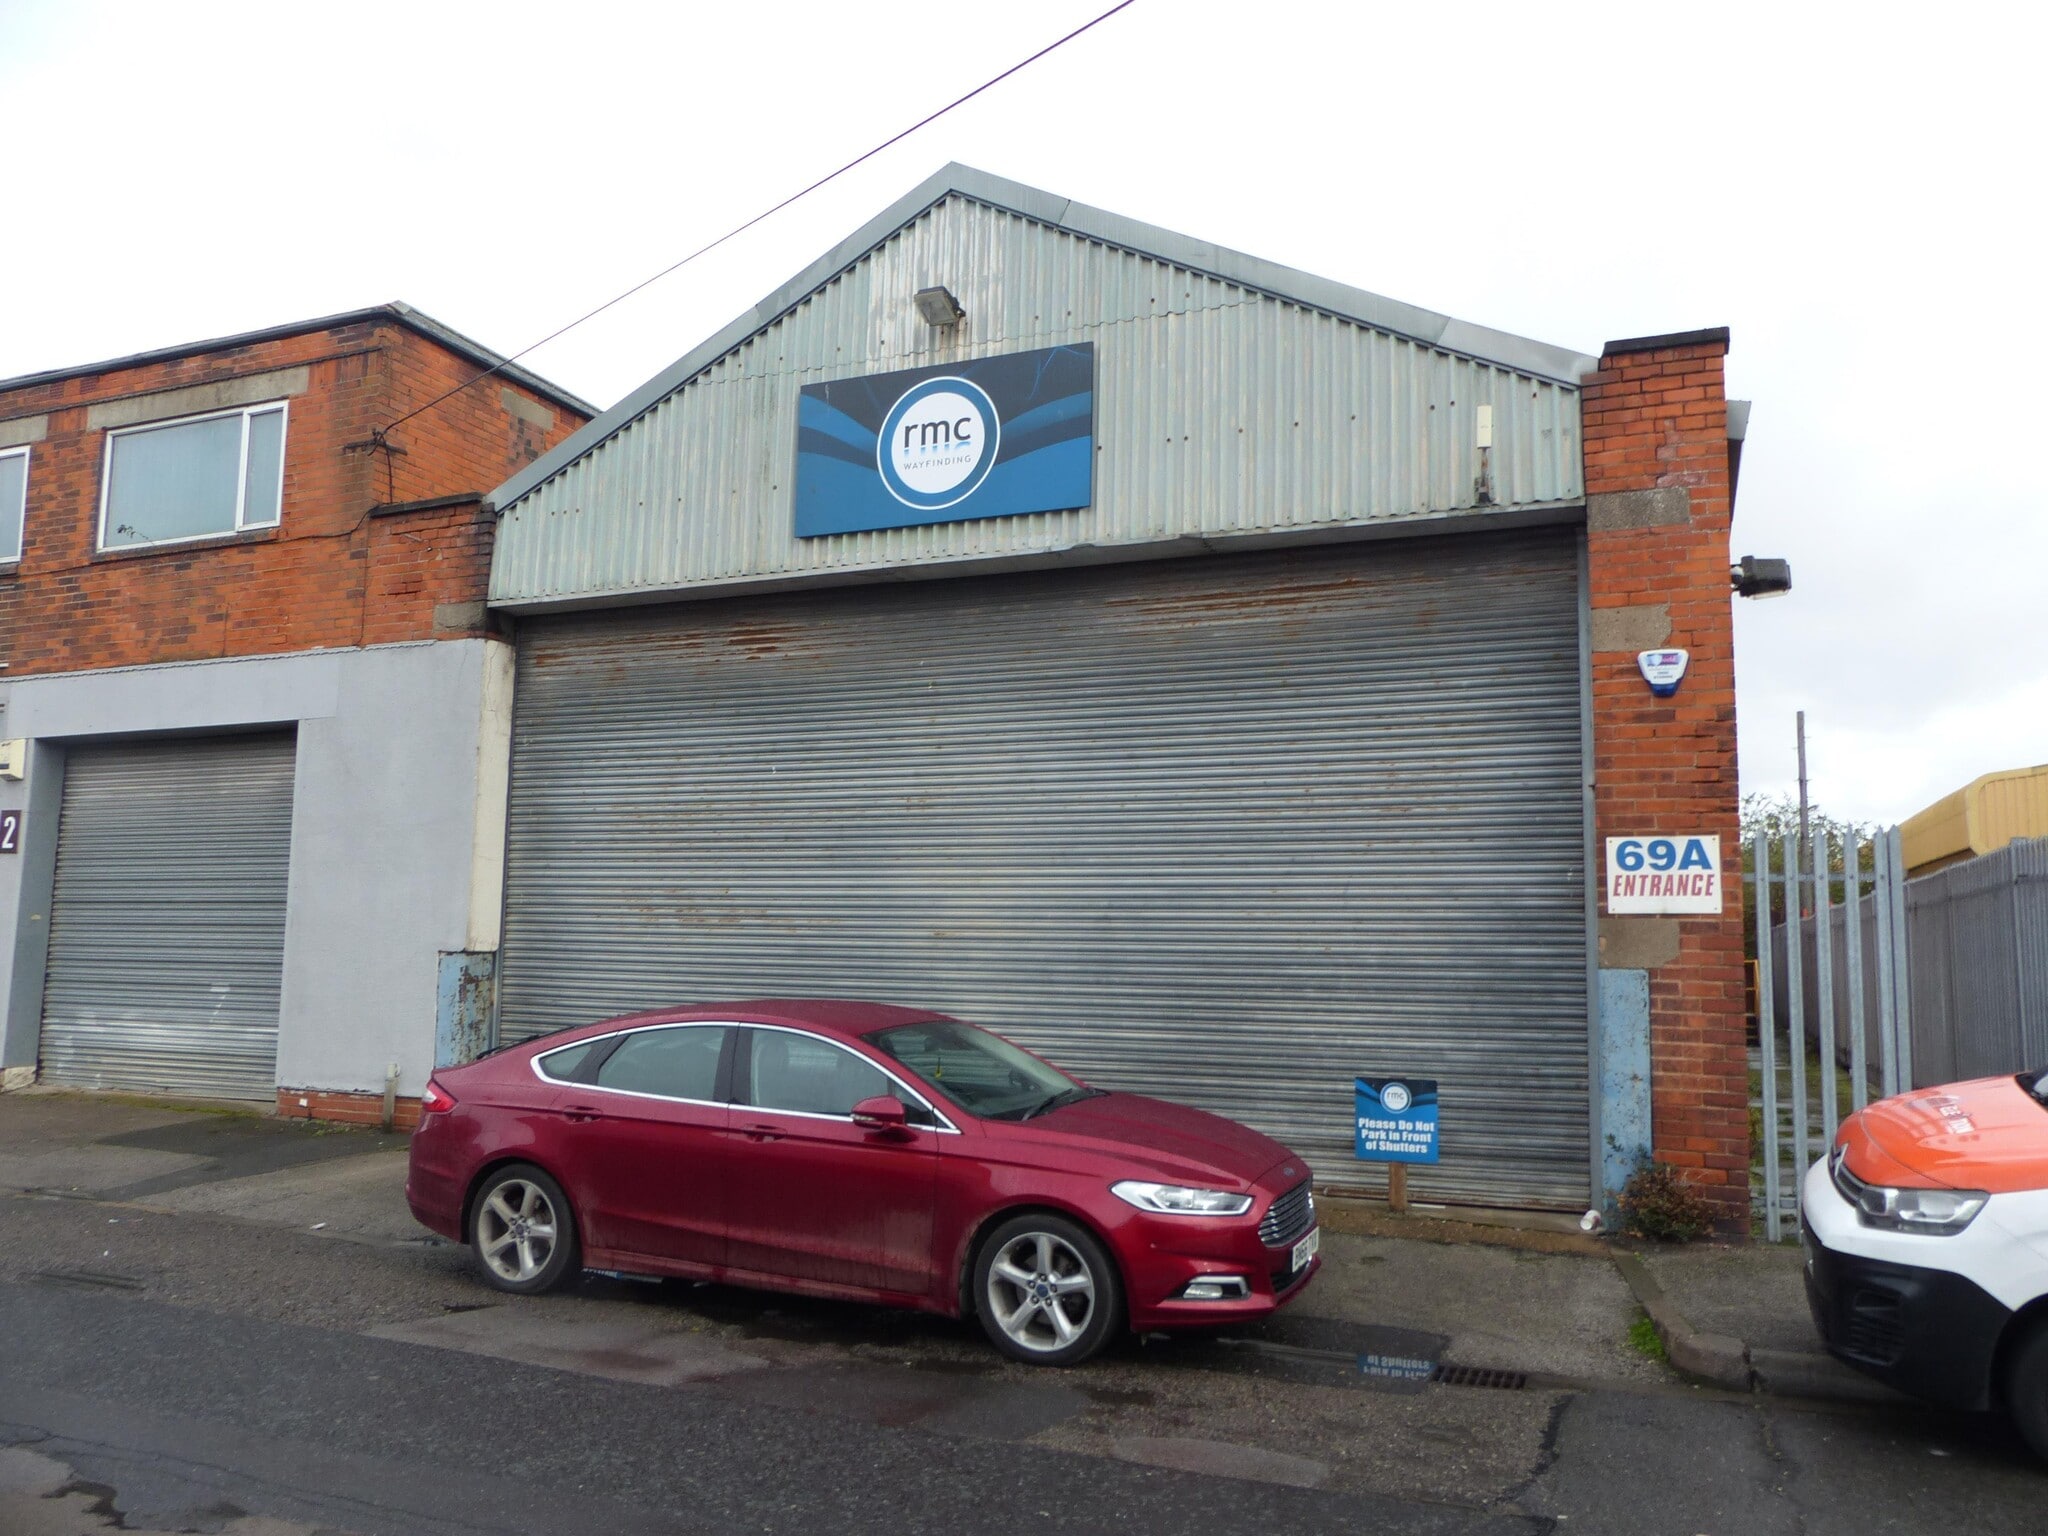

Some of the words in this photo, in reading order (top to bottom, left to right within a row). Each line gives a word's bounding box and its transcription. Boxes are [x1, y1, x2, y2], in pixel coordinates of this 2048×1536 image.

[904, 417, 971, 448] rmc
[903, 455, 971, 470] WAYFINDING
[2, 816, 16, 849] 2
[1616, 839, 1712, 872] 69A
[1613, 874, 1715, 897] ENTRANCE
[1358, 1117, 1396, 1130] Please
[1398, 1120, 1413, 1131] Do
[1415, 1121, 1435, 1132] Not
[1361, 1129, 1387, 1140] Park
[1402, 1131, 1432, 1143] Front
[1365, 1140, 1377, 1151] of
[1379, 1141, 1428, 1154] Shutters
